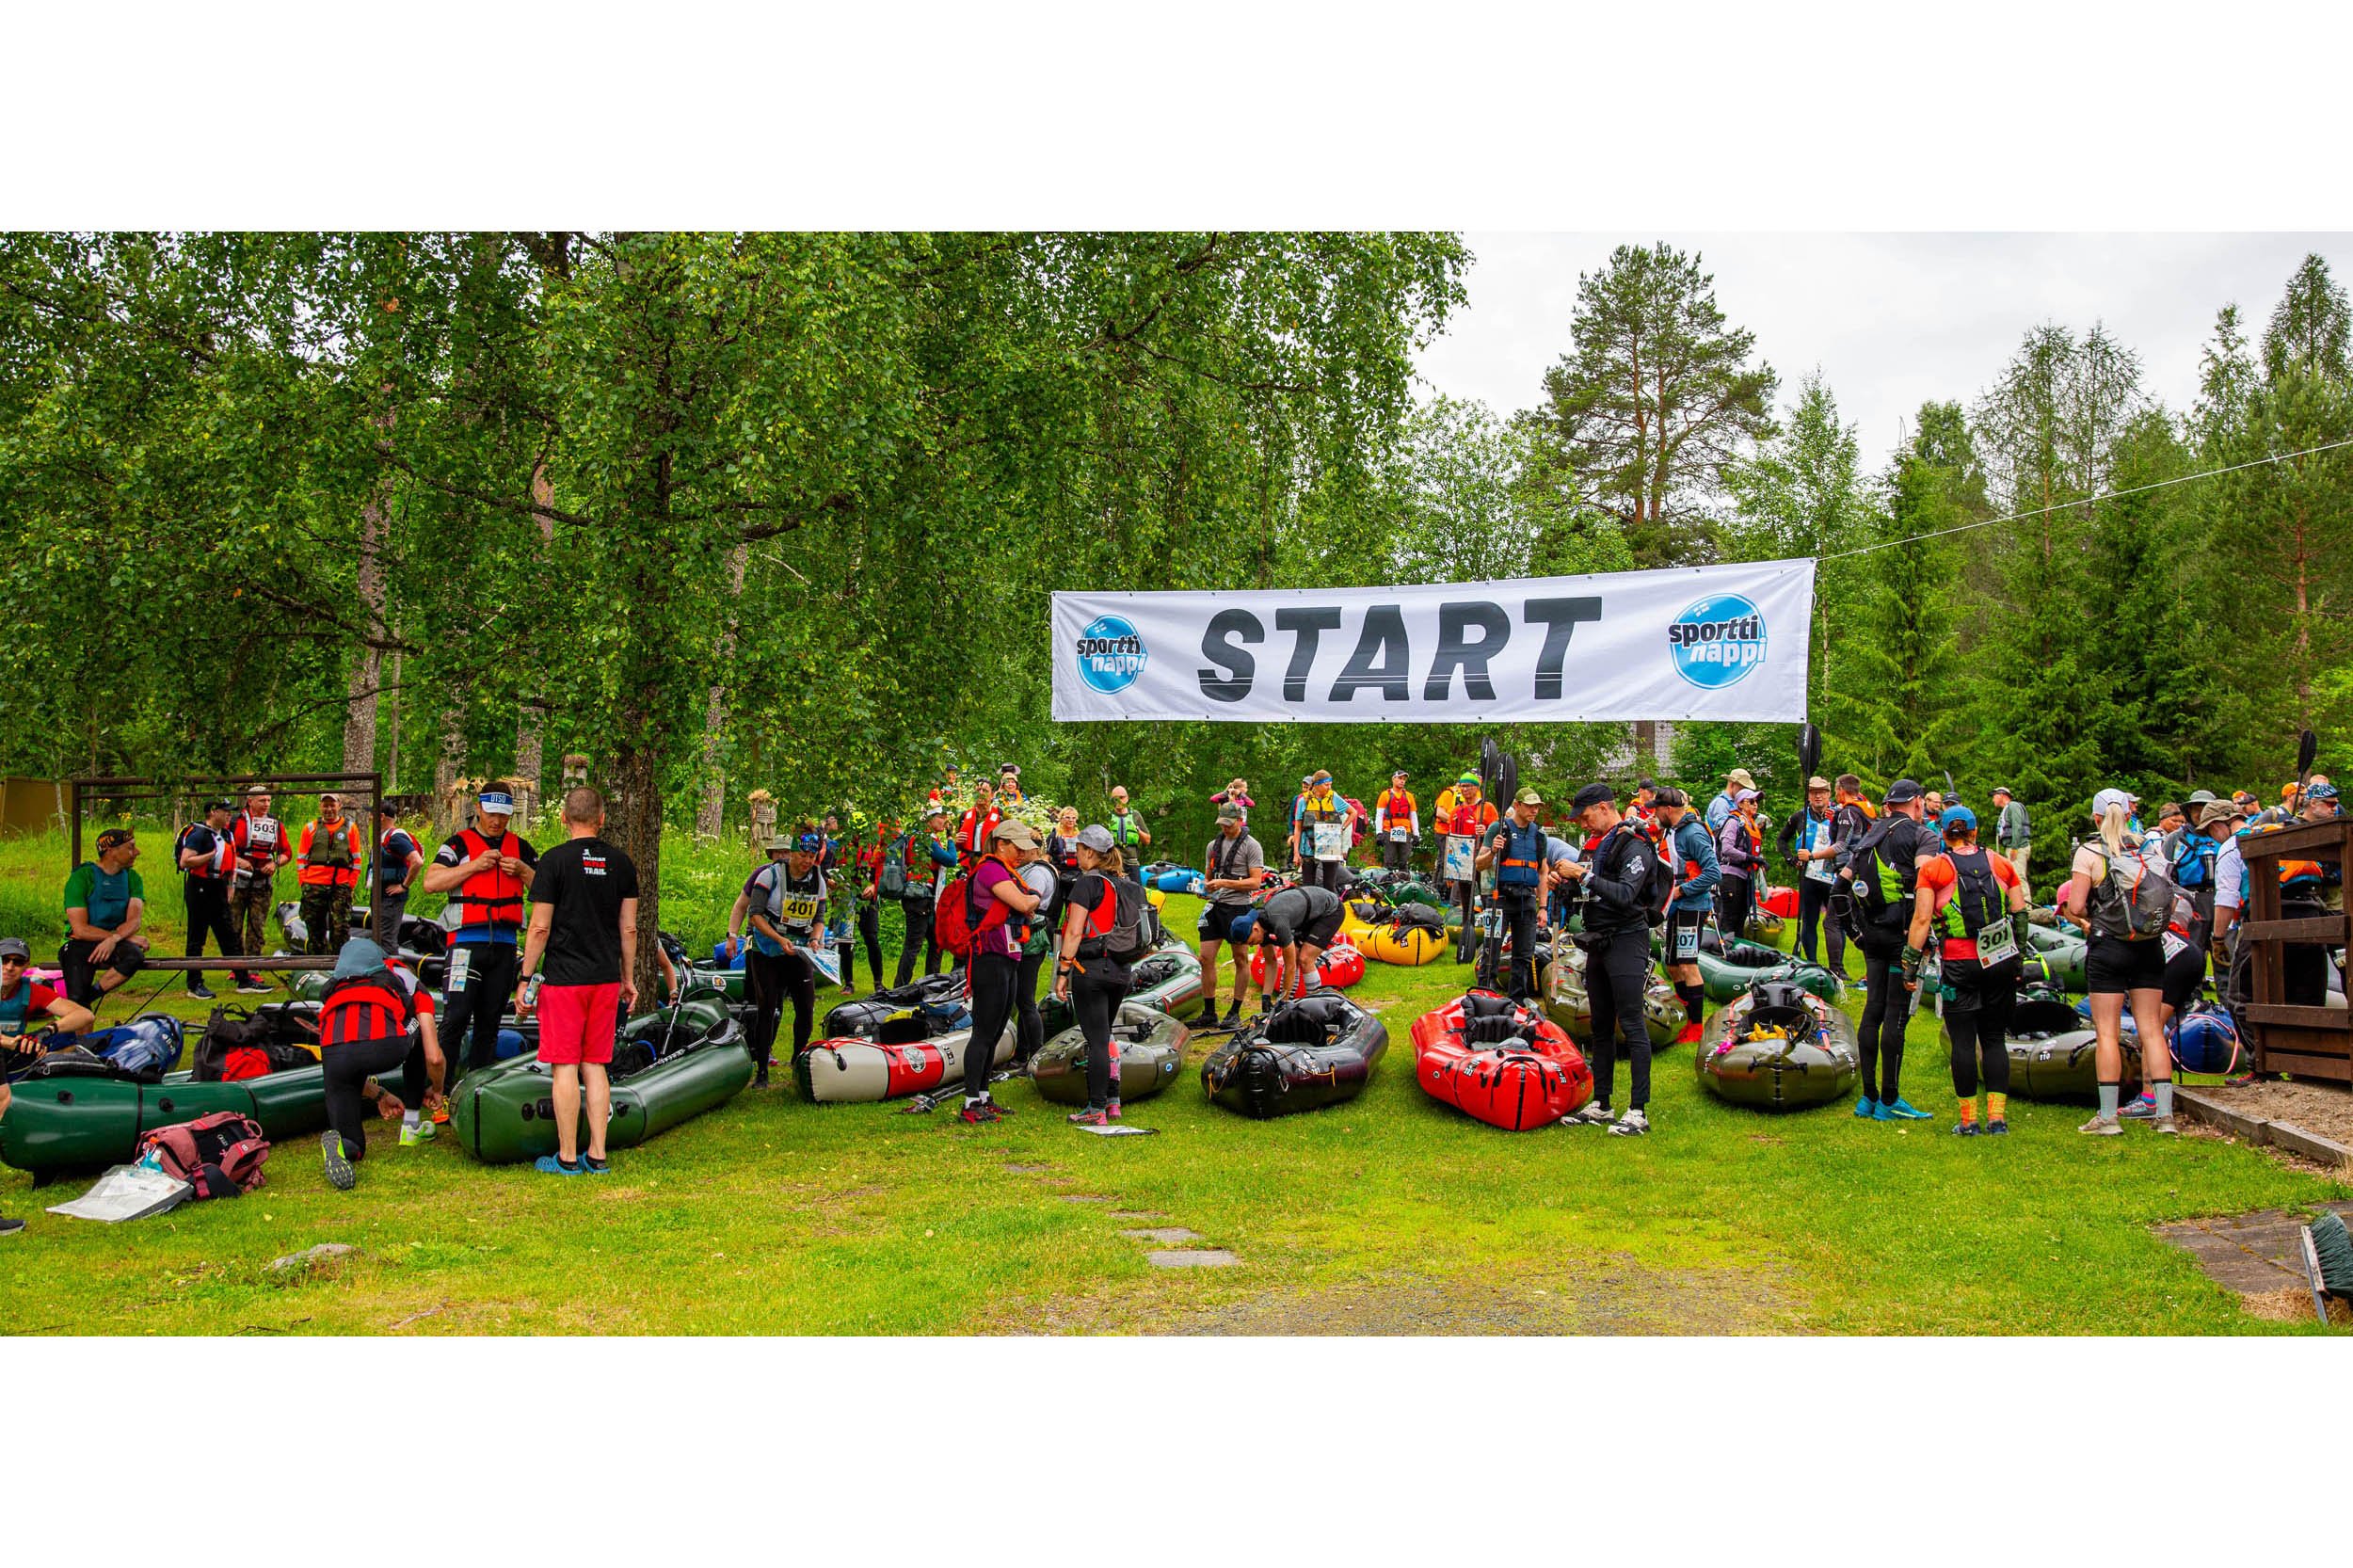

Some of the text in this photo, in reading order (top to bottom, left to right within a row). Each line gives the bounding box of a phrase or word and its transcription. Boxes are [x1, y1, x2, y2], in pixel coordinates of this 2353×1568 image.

[1668, 615, 1758, 648] sportti
[1076, 634, 1141, 659] sportti
[1197, 596, 1603, 703] START
[1689, 637, 1767, 667] nappi
[1092, 653, 1147, 676] nappi
[254, 824, 276, 834] 503
[584, 867, 607, 875] TRAIL
[787, 902, 814, 916] 401
[1676, 934, 1696, 947] 07
[1979, 928, 2009, 951] 301
